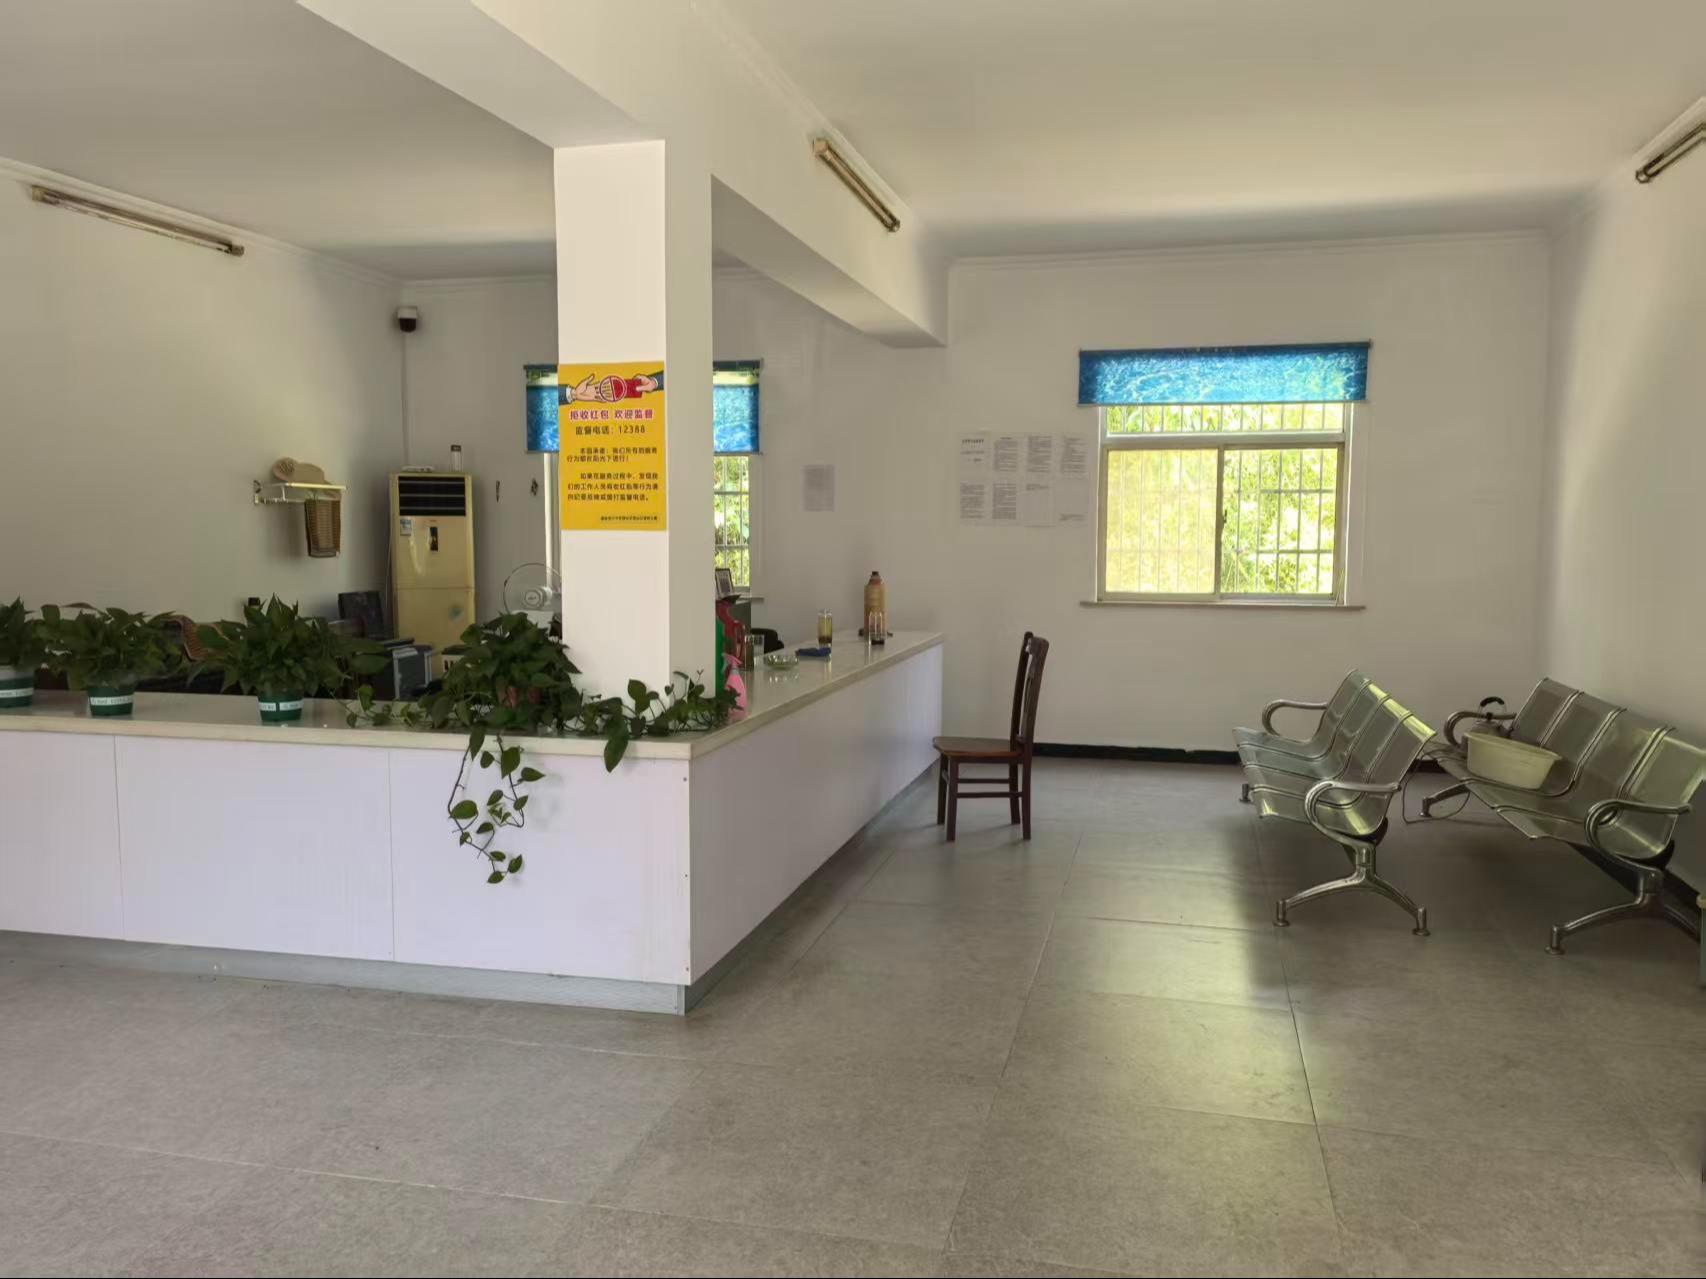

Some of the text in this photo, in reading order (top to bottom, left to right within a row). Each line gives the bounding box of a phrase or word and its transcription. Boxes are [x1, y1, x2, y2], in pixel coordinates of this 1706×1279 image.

[570, 408, 653, 420] 拒收红包 欢迎监督
